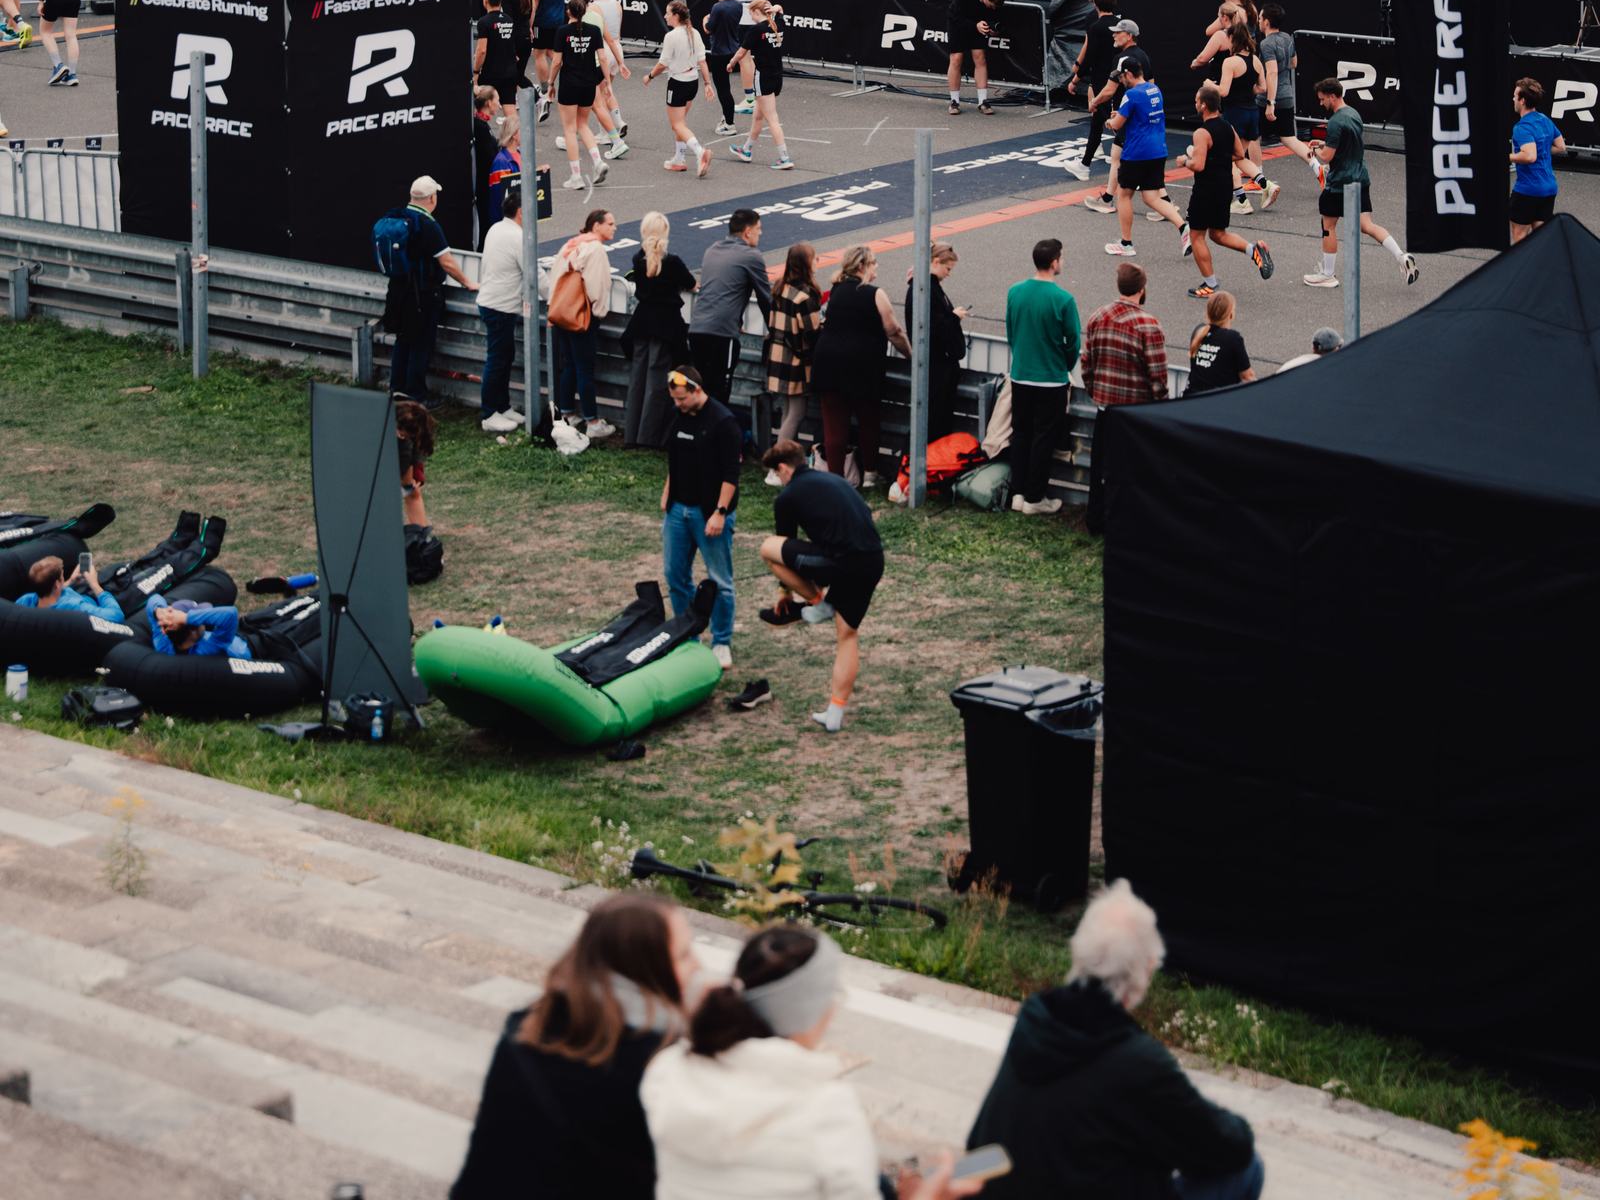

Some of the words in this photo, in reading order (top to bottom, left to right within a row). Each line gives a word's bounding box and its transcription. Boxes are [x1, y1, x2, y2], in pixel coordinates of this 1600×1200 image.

[793, 16, 832, 31] RACE
[151, 110, 191, 129] PAC
[205, 116, 253, 137] RACE
[326, 114, 378, 137] PACE
[381, 105, 436, 128] RACE
[1432, 68, 1476, 215] PACE
